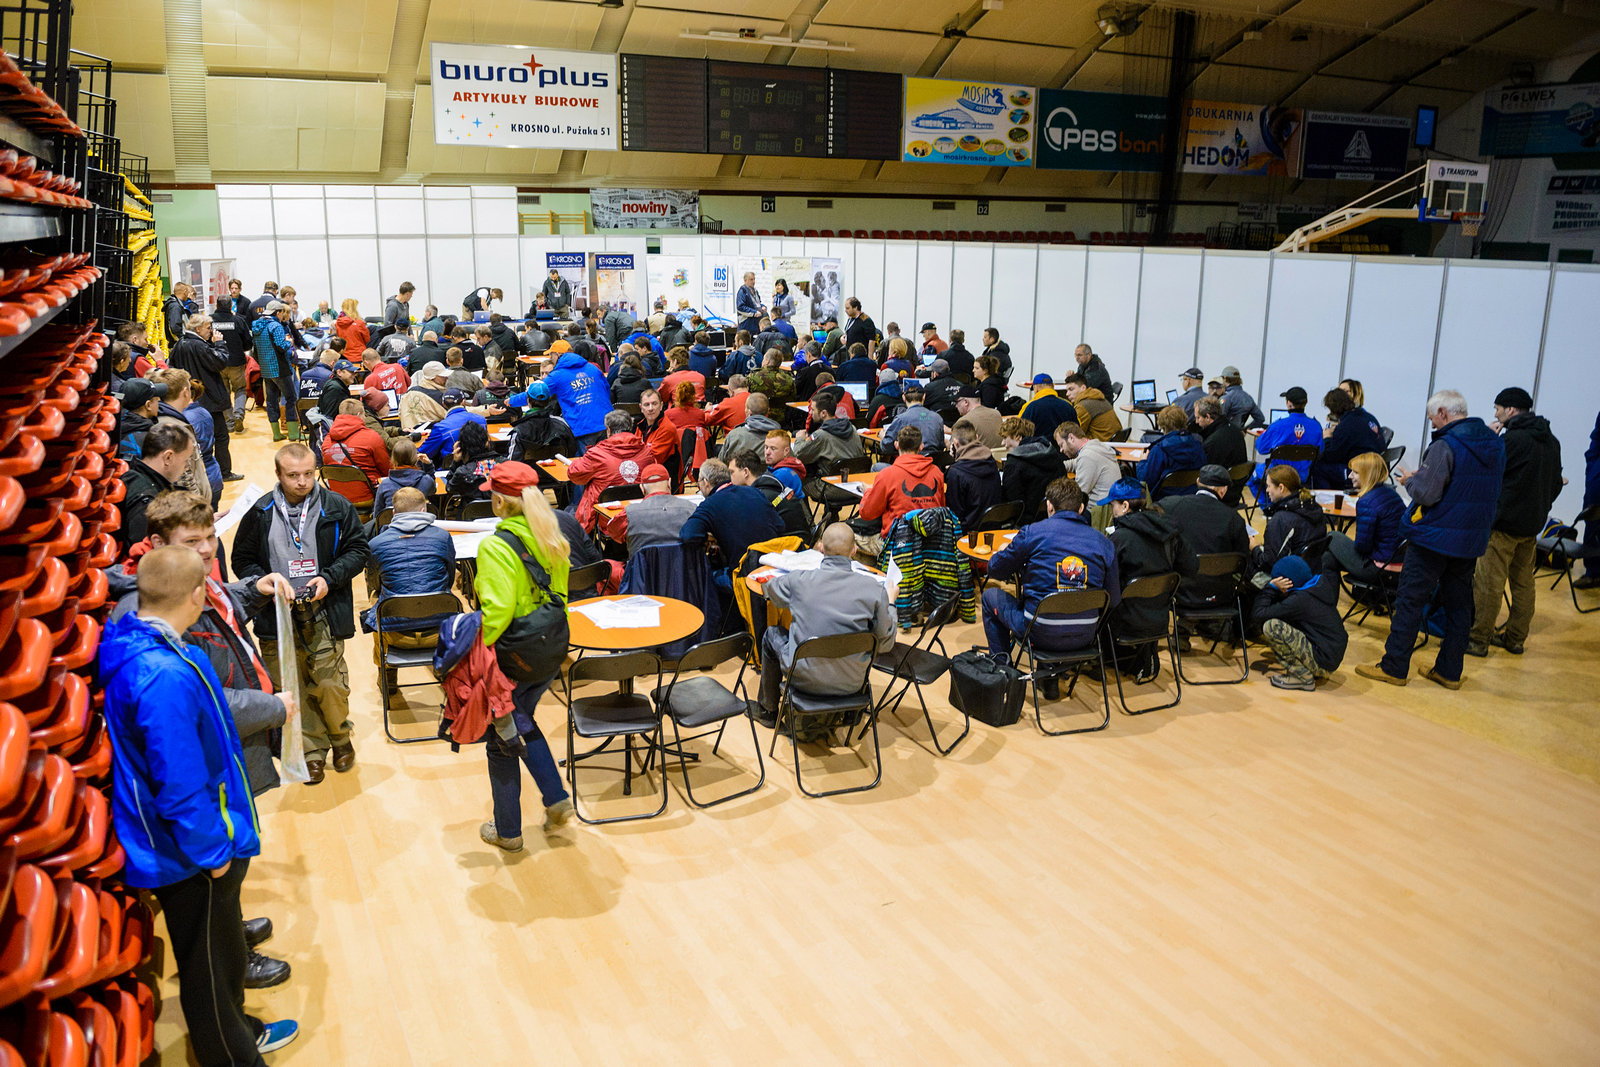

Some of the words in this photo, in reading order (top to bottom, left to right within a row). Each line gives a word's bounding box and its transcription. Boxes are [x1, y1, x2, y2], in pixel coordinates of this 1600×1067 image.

[440, 60, 528, 84] biuro
[538, 67, 608, 88] plus
[453, 91, 527, 105] ARTYKUŁY
[535, 95, 599, 109] BIUROWE
[1186, 107, 1254, 122] DRUKARNIA
[511, 124, 550, 134] KROSNO
[552, 126, 564, 135] ul.
[567, 125, 598, 136] Pużaka
[600, 127, 611, 136] 51
[1064, 128, 1117, 152] PBS
[1183, 146, 1250, 167] HEDOM
[1446, 167, 1478, 177] TRANSITION
[622, 201, 668, 216] nowiny
[763, 202, 774, 211] D1
[978, 205, 988, 214] D2
[556, 255, 583, 264] KROSNO
[605, 257, 632, 266] KROSNO
[714, 268, 727, 281] IDS
